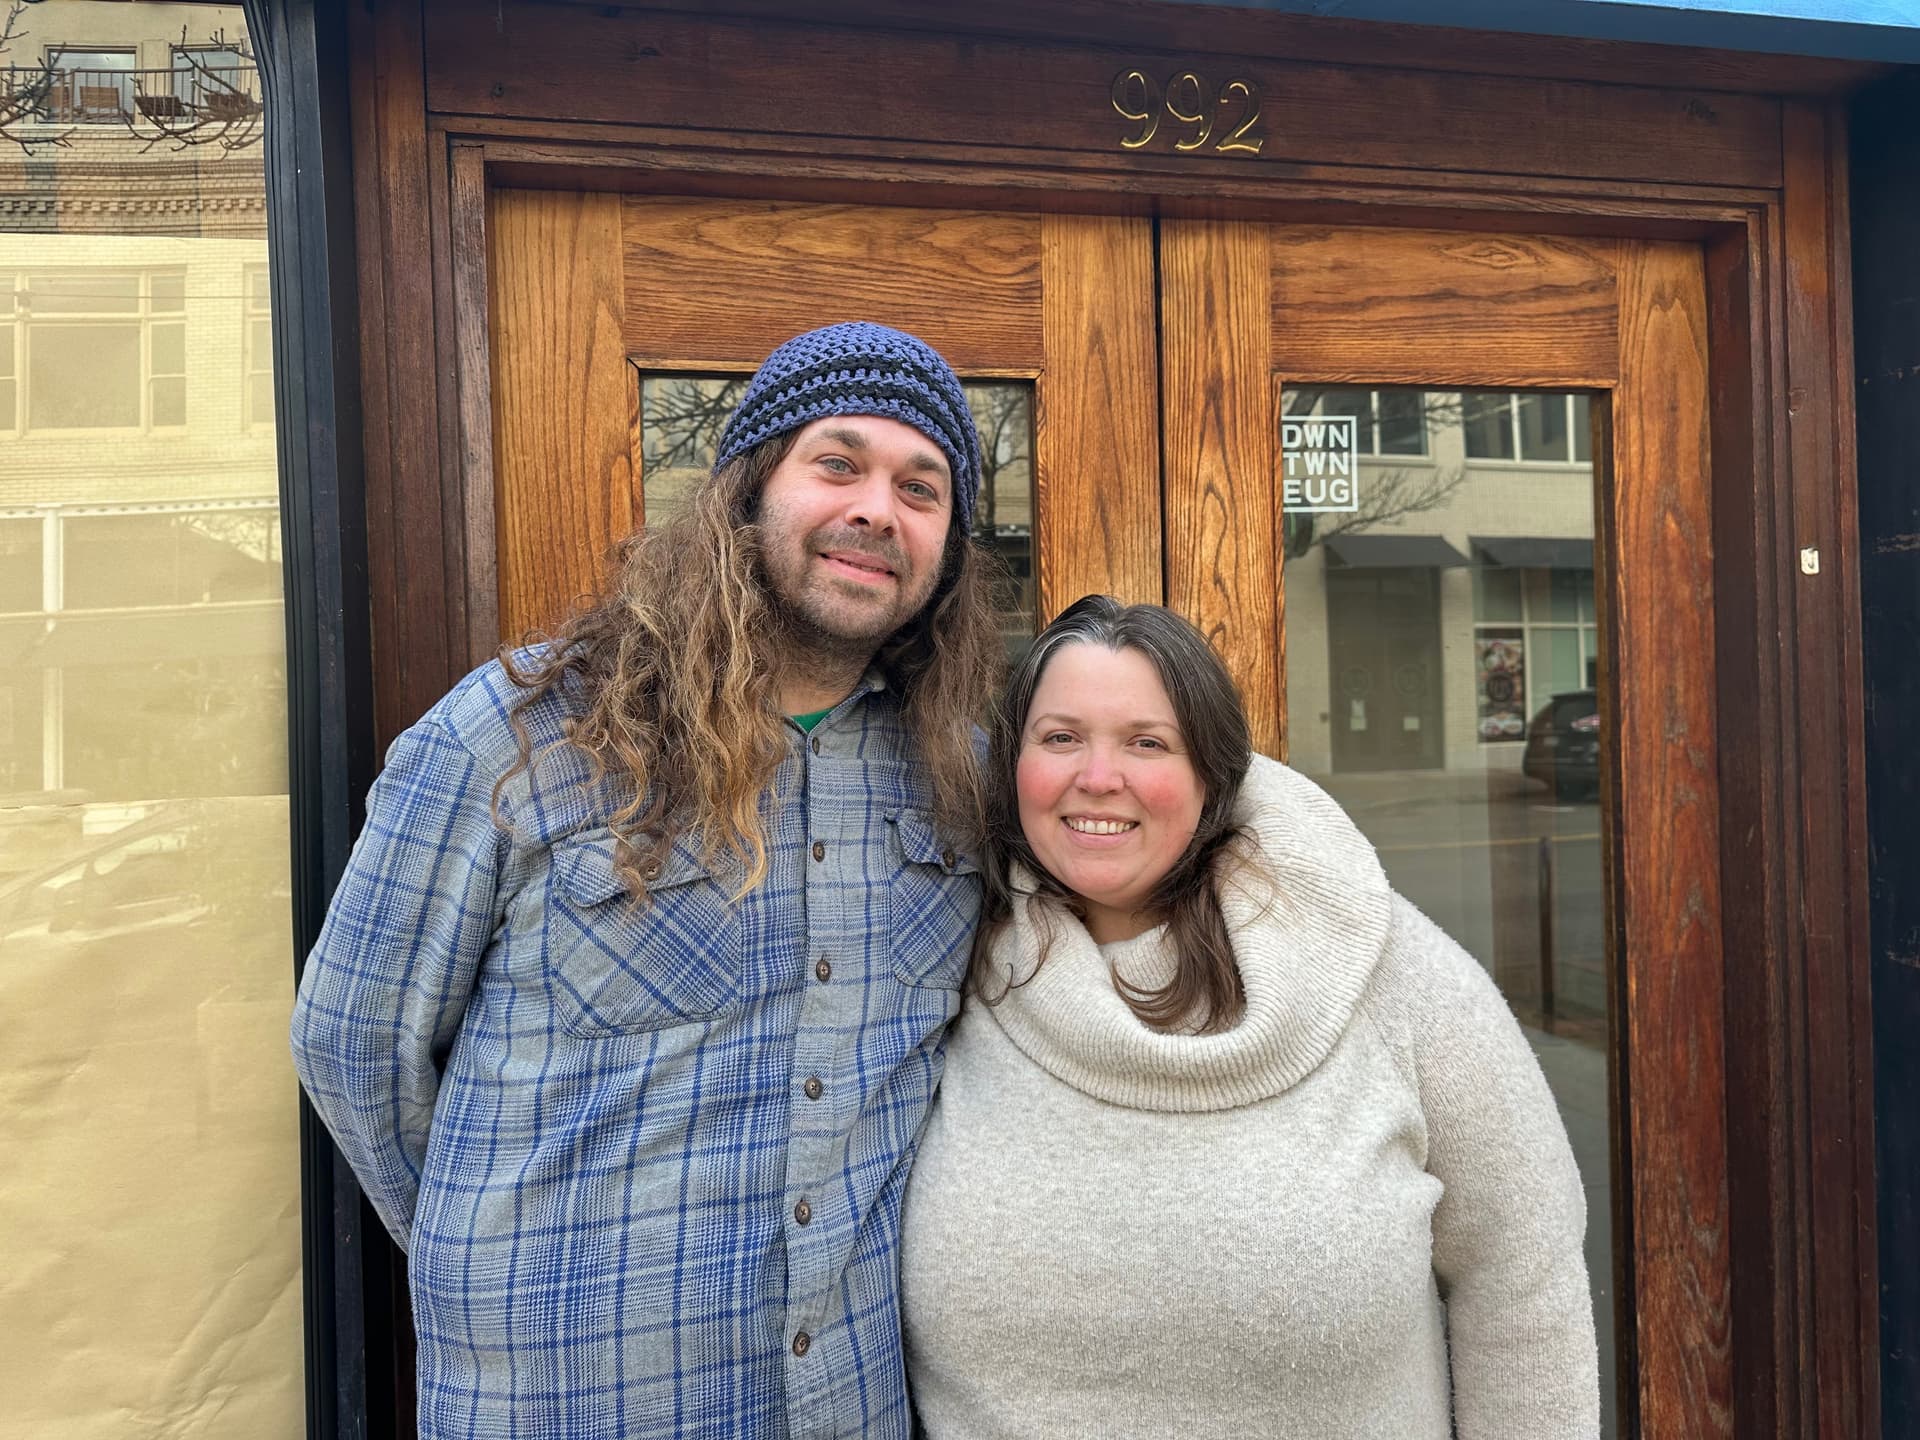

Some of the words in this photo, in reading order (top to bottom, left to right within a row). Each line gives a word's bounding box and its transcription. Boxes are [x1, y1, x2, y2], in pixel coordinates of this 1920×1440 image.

[1112, 69, 1263, 153] 992
[1282, 424, 1349, 448] DWN
[1283, 452, 1349, 475] TWN
[1283, 479, 1349, 503] EUG
